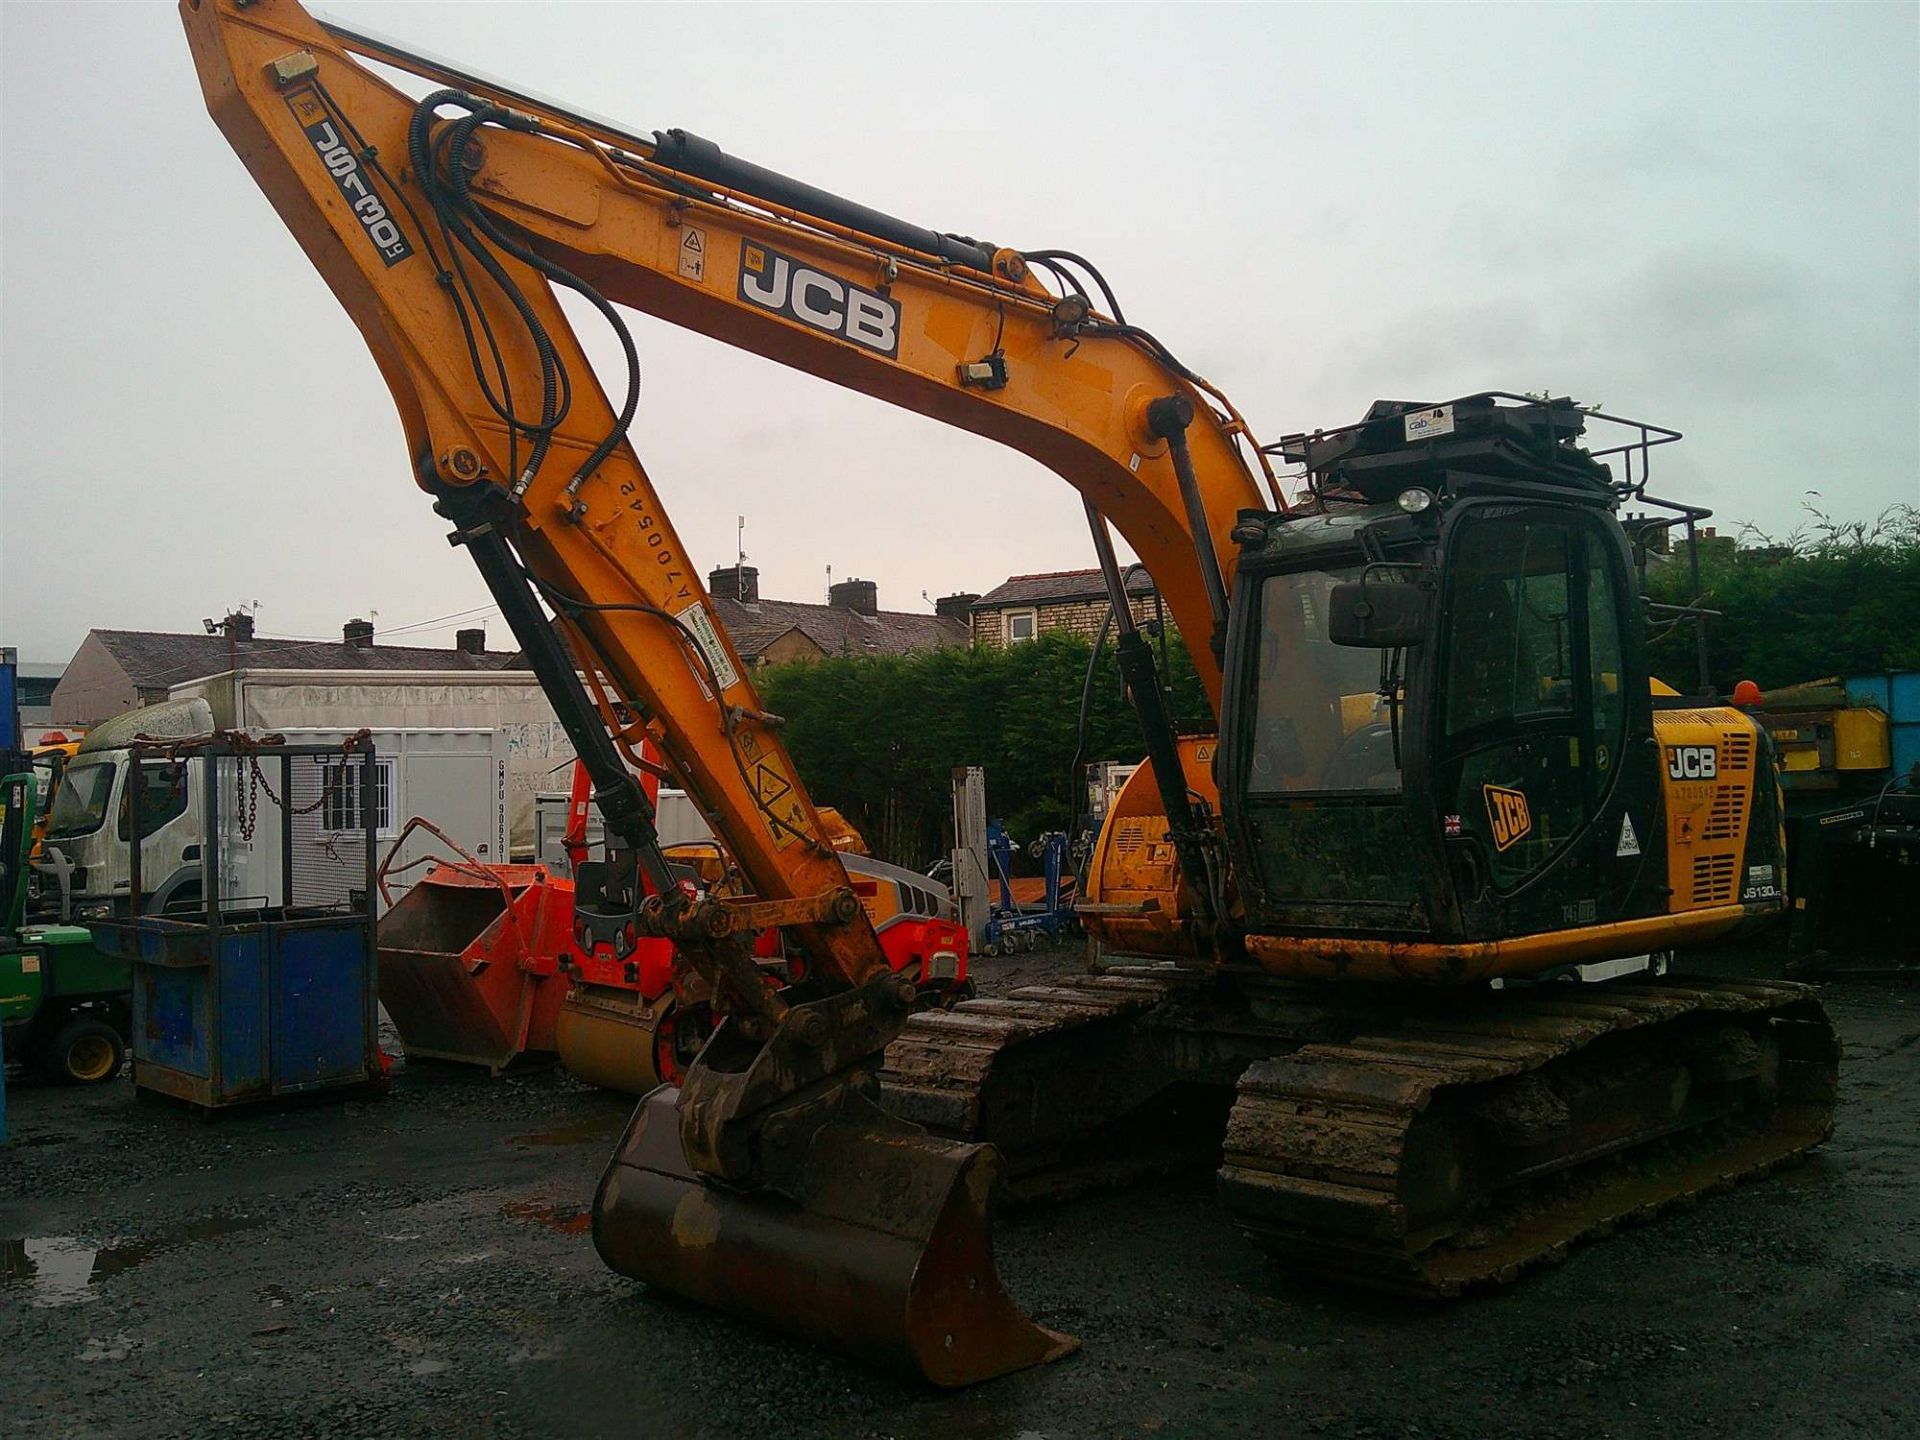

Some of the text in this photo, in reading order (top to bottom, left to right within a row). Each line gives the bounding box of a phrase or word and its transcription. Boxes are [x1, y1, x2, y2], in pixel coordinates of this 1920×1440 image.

[743, 256, 896, 352] JCB
[1669, 747, 1716, 778] JCB
[1492, 790, 1529, 844] JCB
